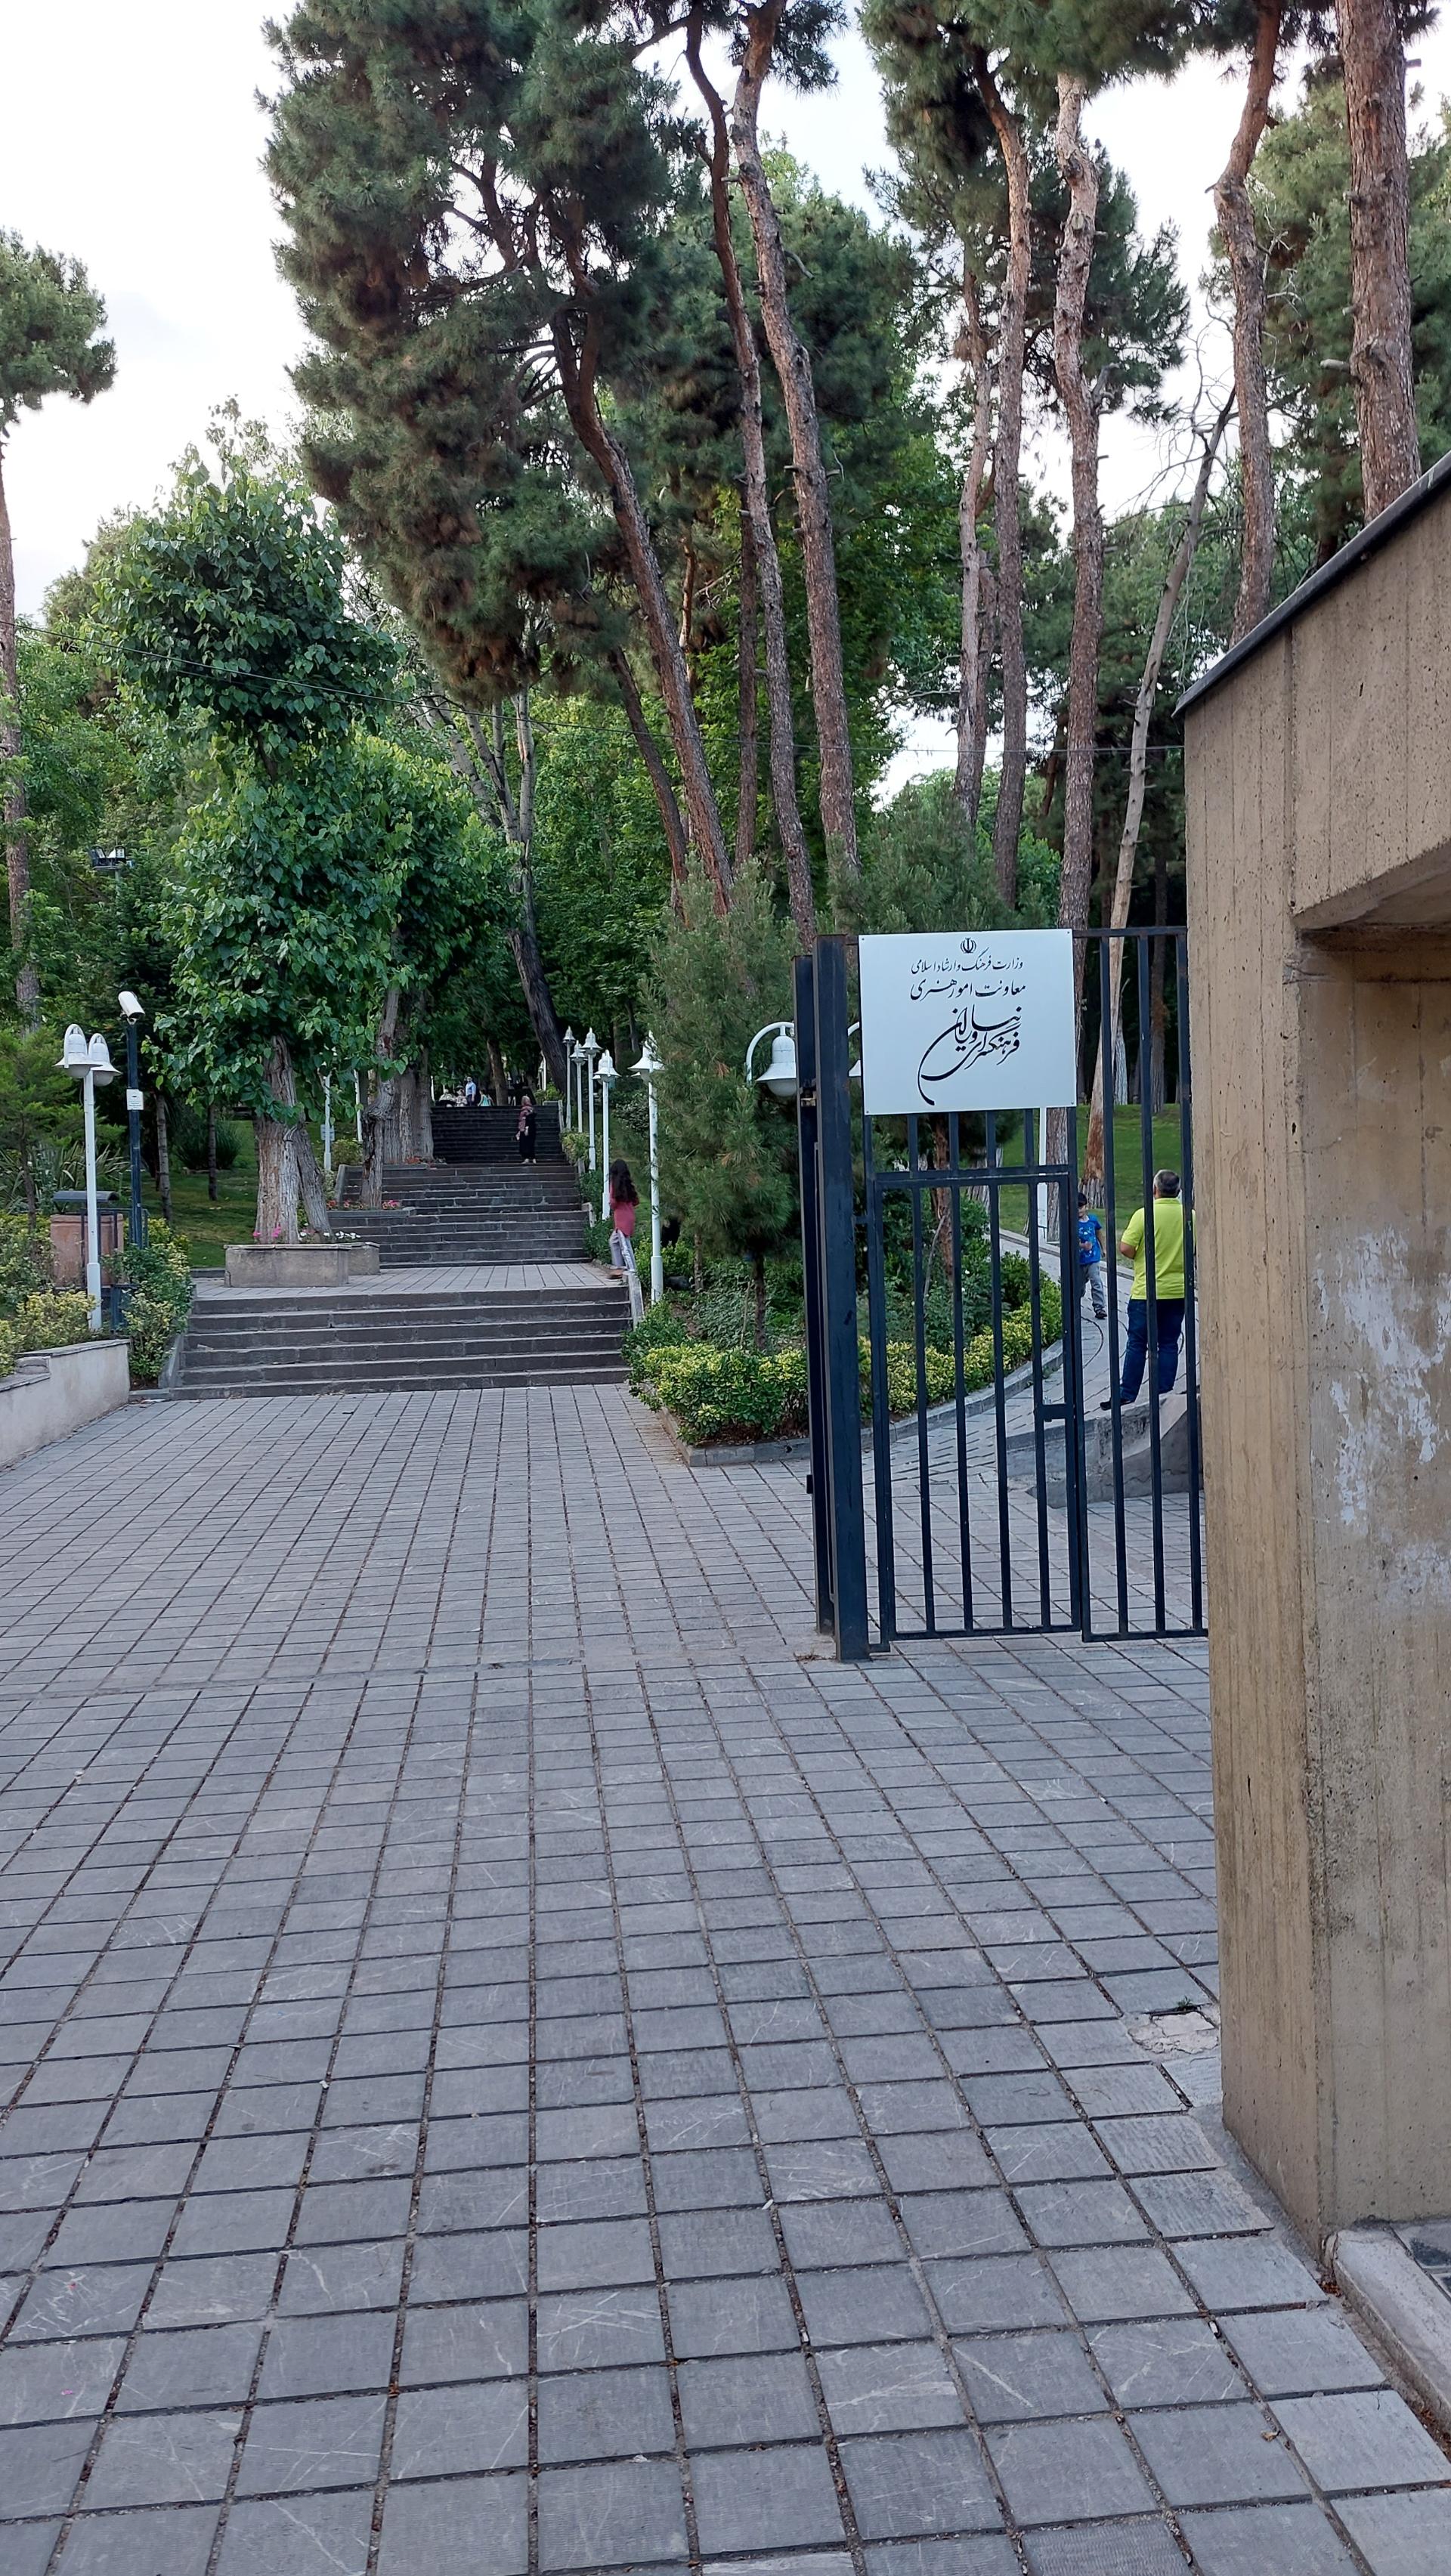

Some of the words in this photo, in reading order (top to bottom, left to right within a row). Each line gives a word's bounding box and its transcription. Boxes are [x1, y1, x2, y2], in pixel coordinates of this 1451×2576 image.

[911, 959, 936, 974] اسلامی
[937, 958, 957, 972] ارشاد
[961, 947, 992, 971] فرهنگ
[992, 957, 1023, 969] وزارت
[910, 979, 958, 1001] هنری
[948, 982, 973, 998] امور
[975, 979, 1026, 997] معاونت
